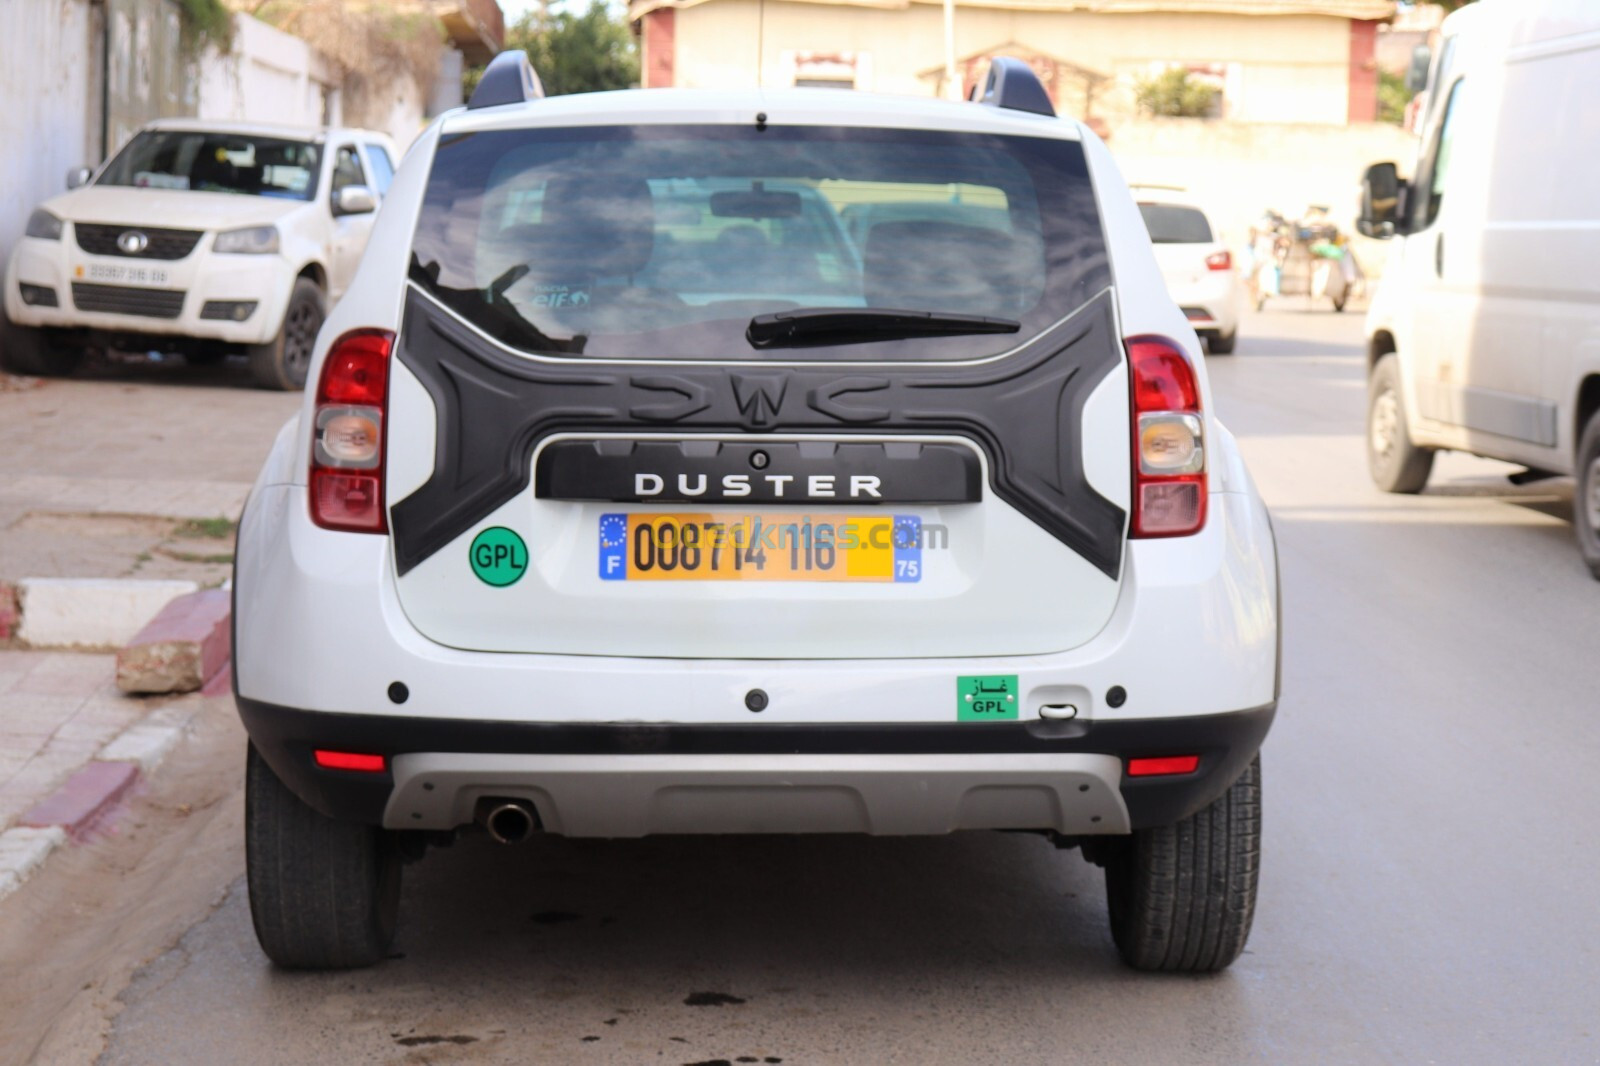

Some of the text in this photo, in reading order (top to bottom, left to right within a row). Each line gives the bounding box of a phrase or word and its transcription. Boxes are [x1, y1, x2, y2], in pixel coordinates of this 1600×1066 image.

[635, 473, 882, 498] DUSTER
[476, 543, 523, 569] GPL
[607, 555, 621, 575] F
[897, 560, 919, 578] 75
[972, 701, 1006, 713] GPL
